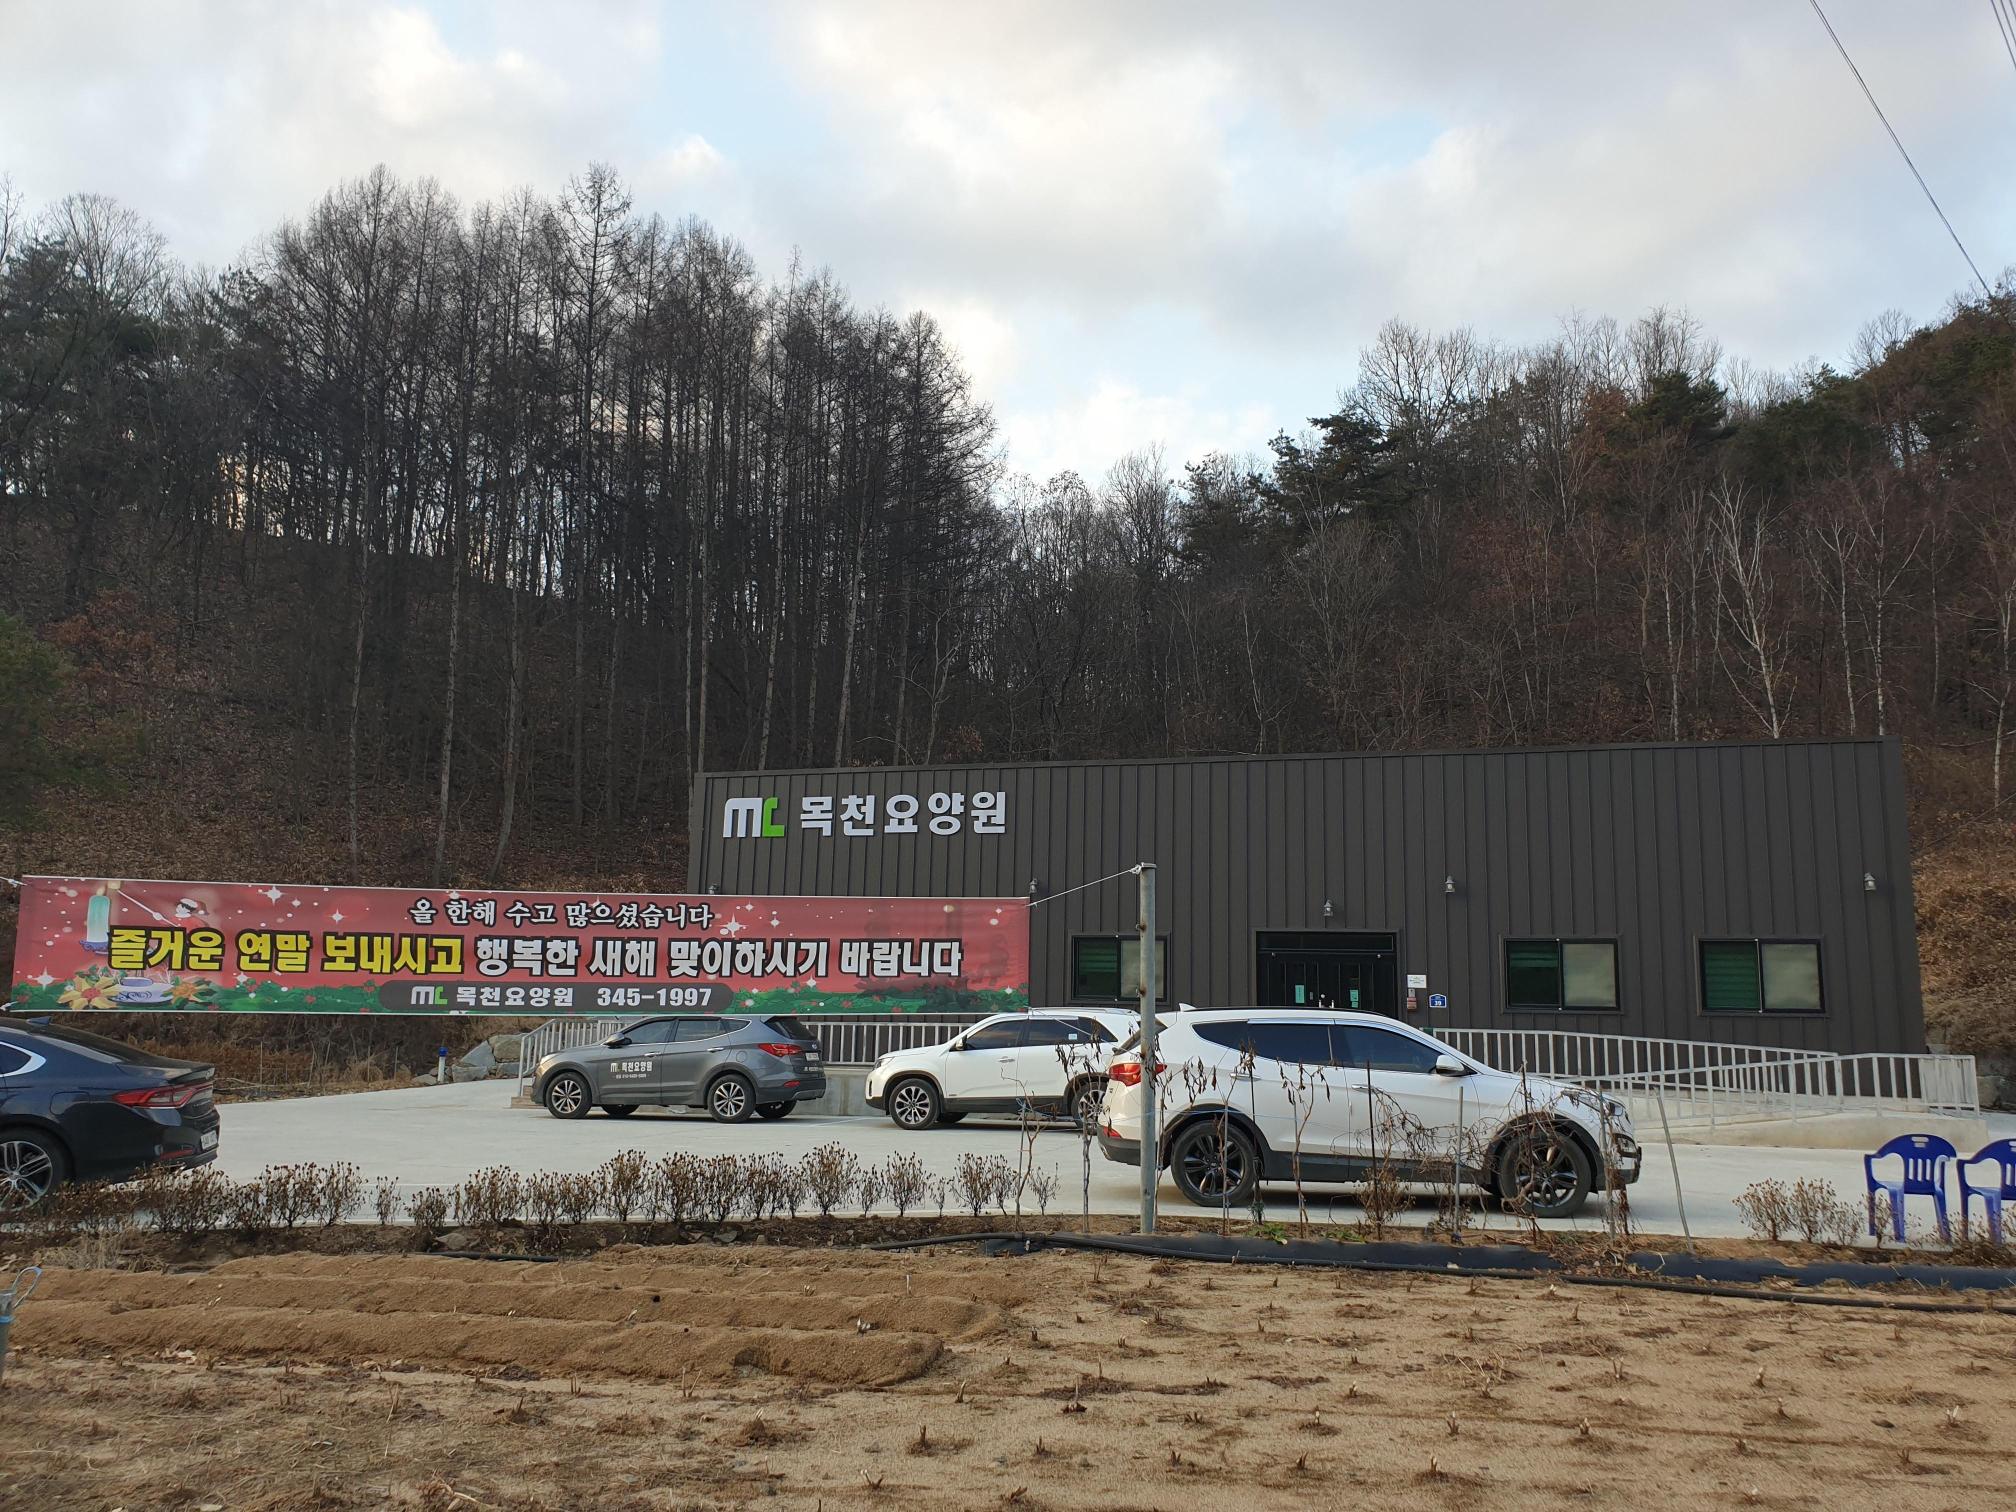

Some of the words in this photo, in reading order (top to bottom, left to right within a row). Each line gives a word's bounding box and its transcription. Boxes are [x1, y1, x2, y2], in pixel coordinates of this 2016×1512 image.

[800, 791, 1006, 837] 목천요양원
[410, 899, 437, 924] 올
[446, 900, 496, 926] 한해
[505, 902, 556, 927] 수고
[566, 903, 713, 929] 많으셨습니다
[109, 929, 223, 970] 즐거운
[239, 931, 310, 971] 연말
[325, 933, 461, 974] 보내시고
[477, 937, 578, 976] 행복한
[590, 940, 655, 977] 새해
[670, 940, 826, 977] 맞이하시기
[841, 941, 962, 977] 바랍니다
[457, 986, 573, 1006] 목천요양원
[597, 987, 712, 1006] 345-1997
